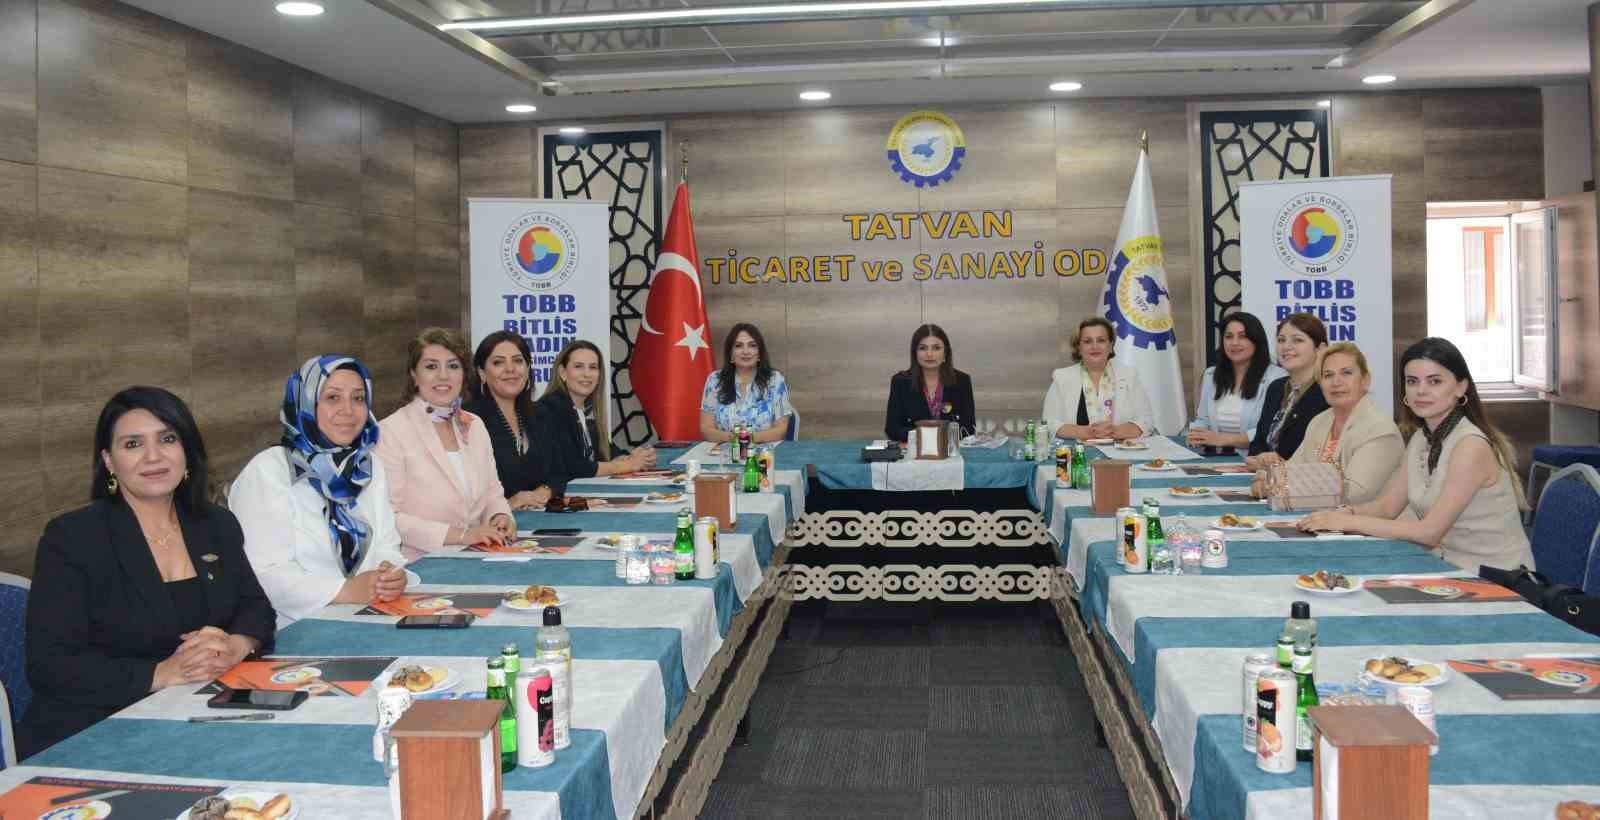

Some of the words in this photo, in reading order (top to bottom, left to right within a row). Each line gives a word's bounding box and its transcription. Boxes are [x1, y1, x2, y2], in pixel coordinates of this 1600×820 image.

[843, 210, 1013, 241] TATVAN
[704, 249, 856, 285] TİCARET
[862, 259, 904, 282] ve
[913, 241, 1045, 281] SANAYİ
[1275, 279, 1355, 299] TOBB
[502, 294, 576, 313] TOBB
[503, 316, 577, 335] BİTLİS
